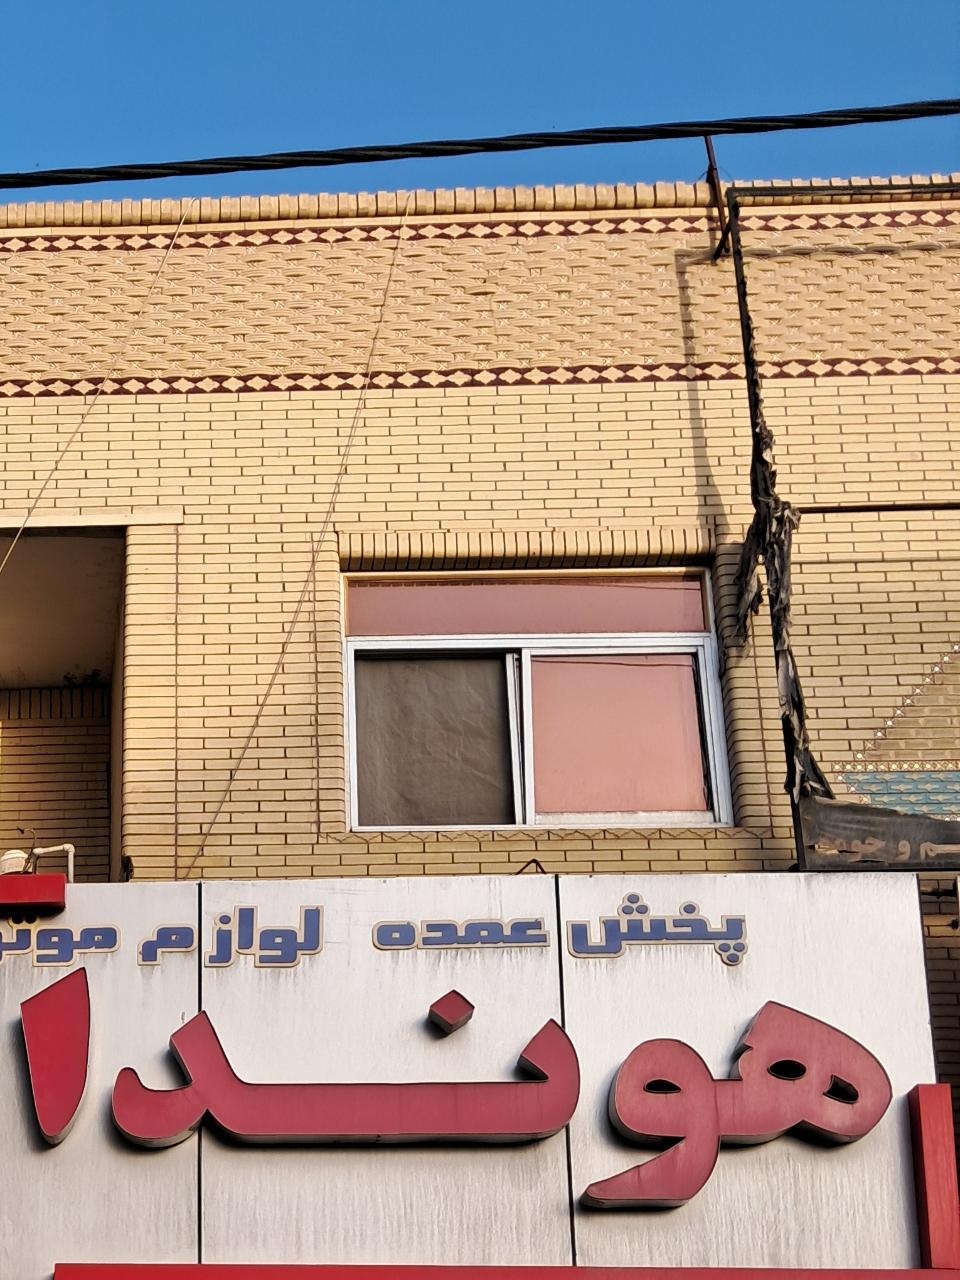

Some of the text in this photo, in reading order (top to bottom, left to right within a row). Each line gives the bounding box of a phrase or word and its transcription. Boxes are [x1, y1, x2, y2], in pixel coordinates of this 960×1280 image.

[136, 904, 325, 968] لوازم
[372, 916, 551, 951] عمده
[566, 891, 748, 967] پخش
[20, 968, 893, 1209] هوندا
